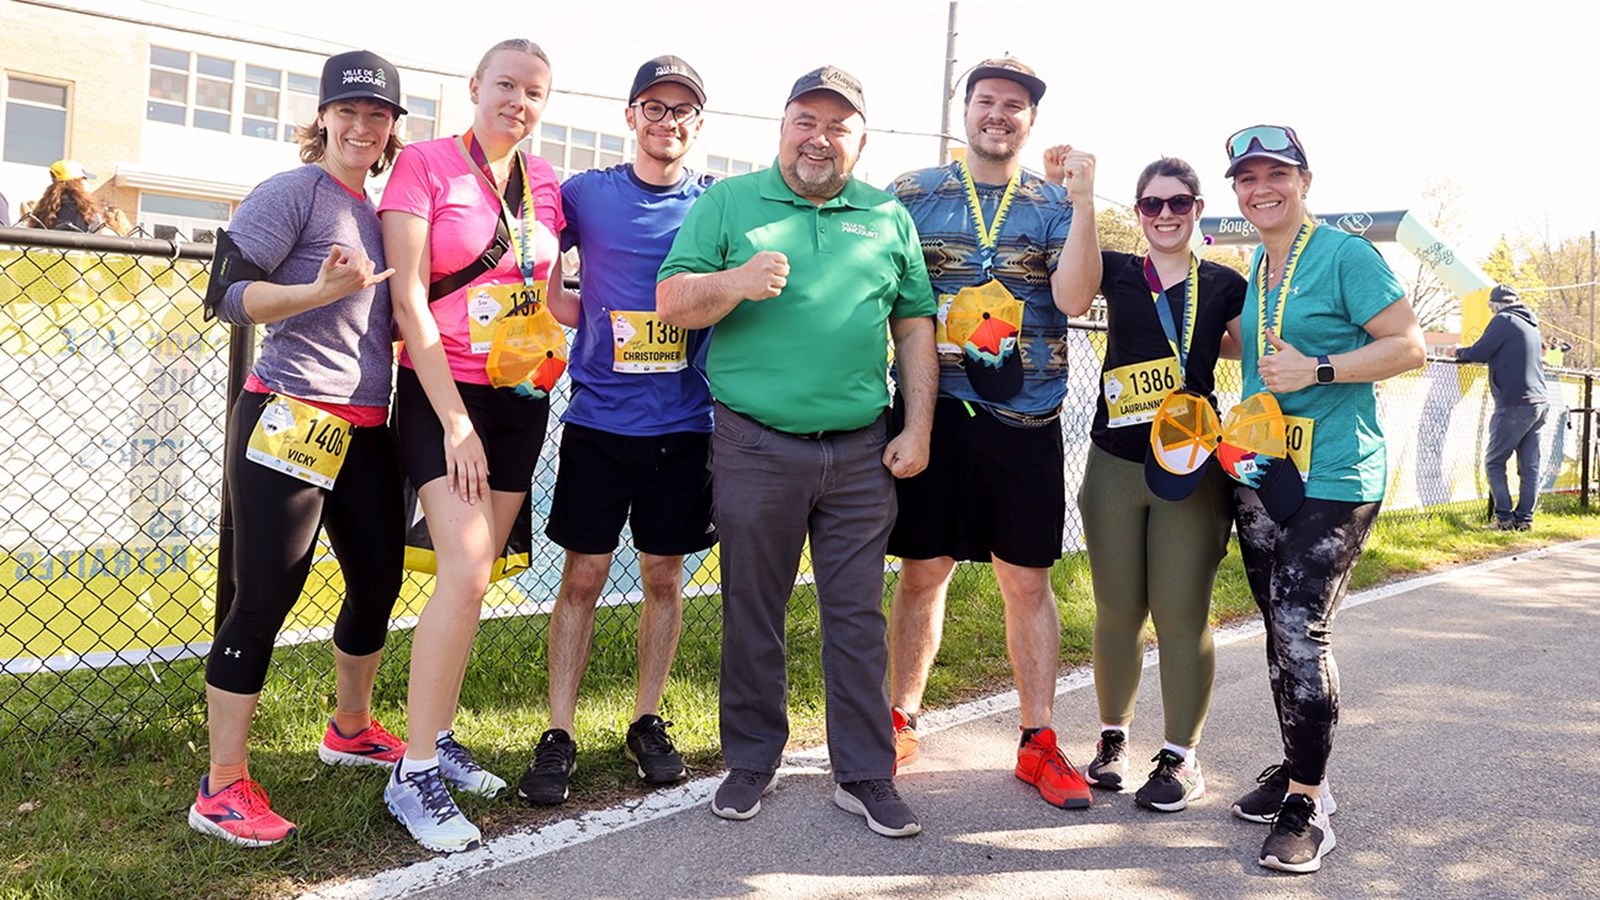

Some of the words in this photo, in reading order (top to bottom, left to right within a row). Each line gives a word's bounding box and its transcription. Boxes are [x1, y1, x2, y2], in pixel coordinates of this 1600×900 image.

[342, 69, 362, 77] VILLE
[363, 69, 373, 77] DE
[623, 351, 681, 361] CHRISTOPHER
[1129, 366, 1175, 395] 1386
[1120, 398, 1165, 415] LAURIANN
[304, 418, 346, 457] 1406
[287, 448, 317, 467] VICKY
